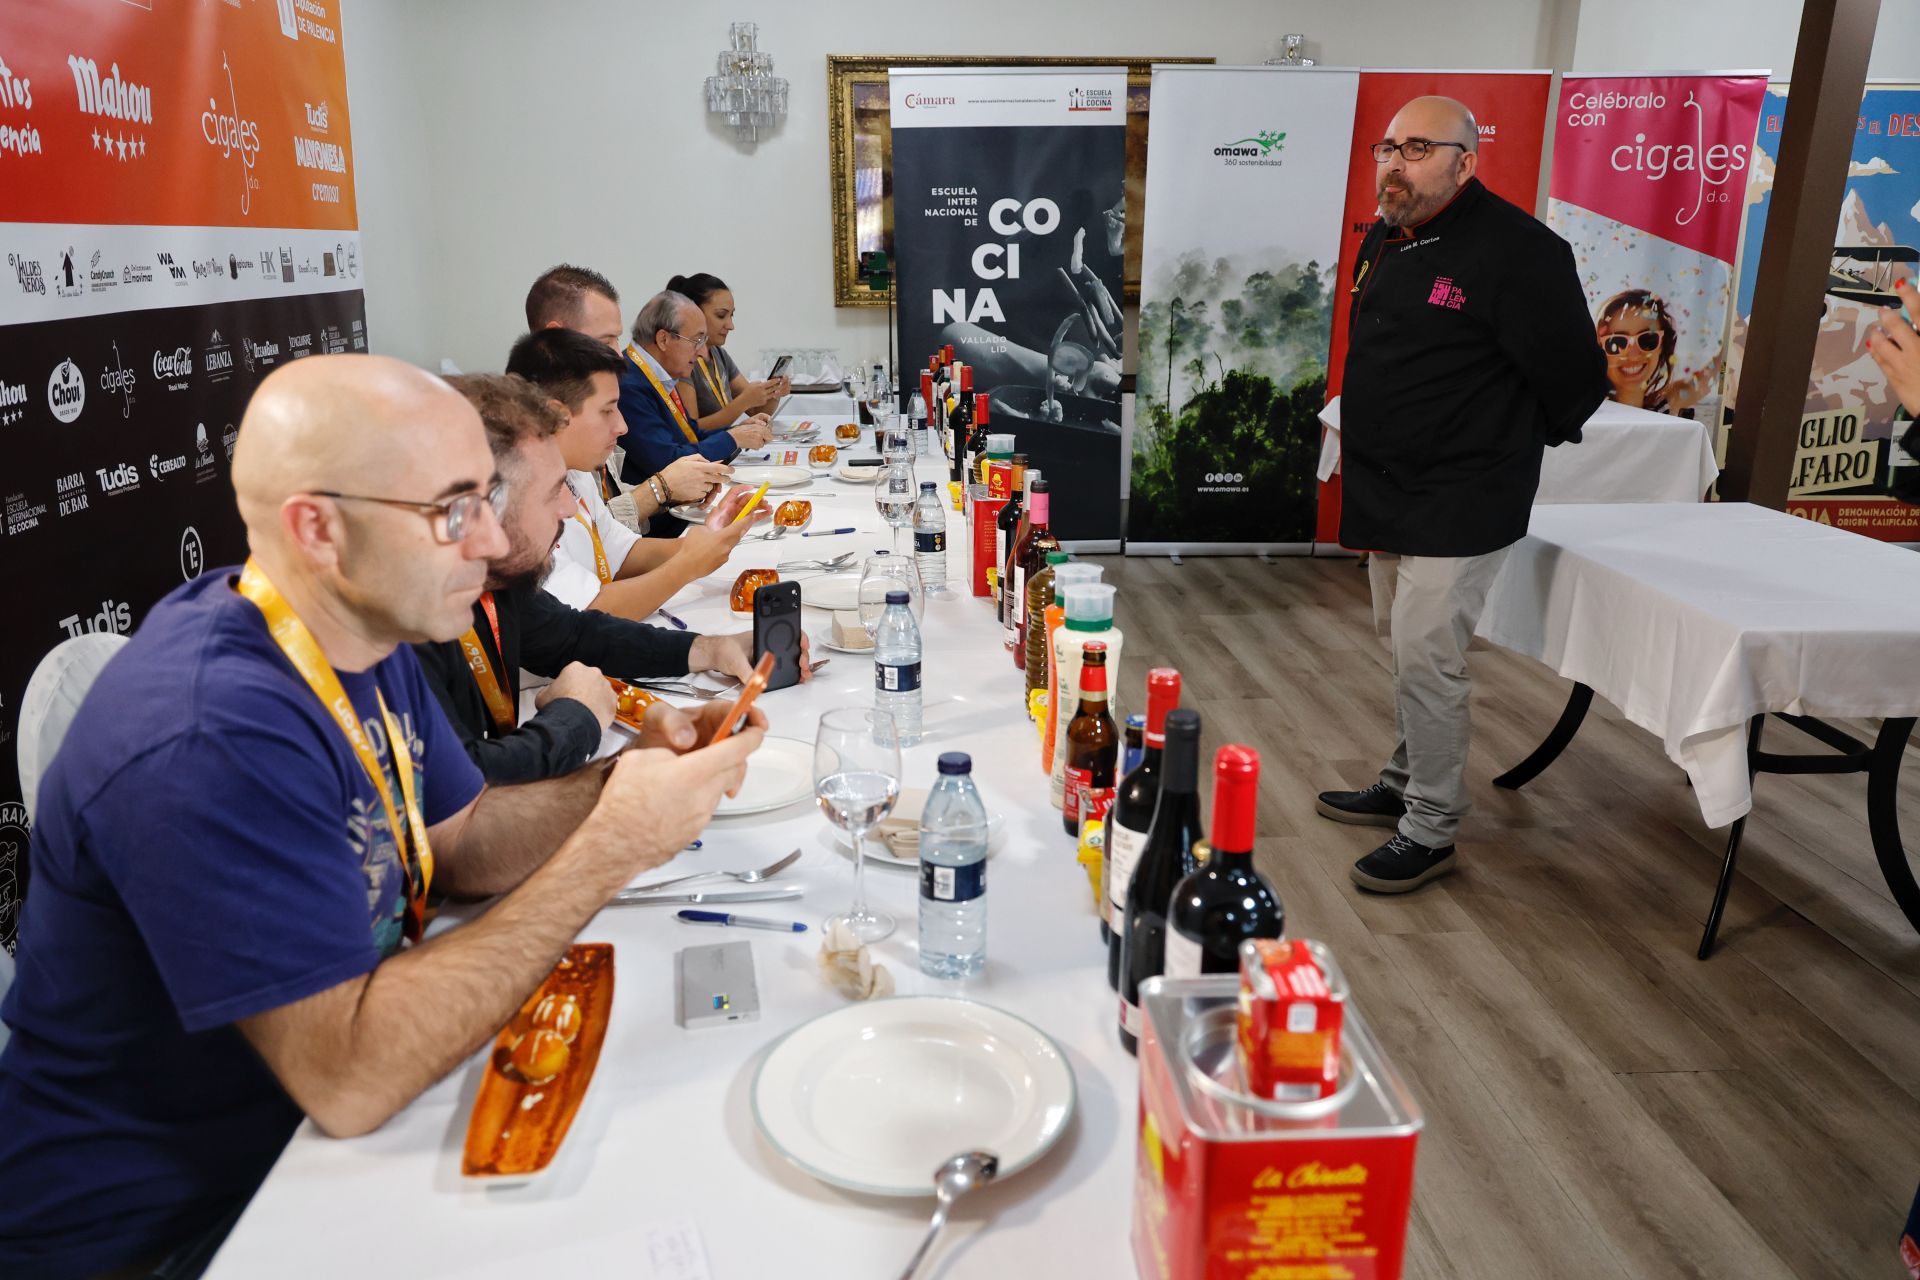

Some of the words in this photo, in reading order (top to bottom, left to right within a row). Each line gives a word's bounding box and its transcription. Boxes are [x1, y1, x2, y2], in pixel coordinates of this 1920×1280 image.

[298, 16, 307, 33] DE
[307, 19, 336, 44] PALENCIA
[67, 54, 152, 125] Mahou
[905, 93, 956, 109] Cámara
[1086, 99, 1112, 107] COCINA
[1569, 91, 1666, 111] Celébralo
[304, 101, 329, 129] Tudis
[1567, 112, 1606, 127] con
[1477, 125, 1496, 135] VAS
[1766, 115, 1783, 133] EL
[1868, 119, 1882, 135] EL
[1213, 147, 1258, 157] omawa
[1224, 158, 1238, 166] 360
[1238, 158, 1283, 167] sostenibilidad
[931, 187, 978, 196] ESCUELA
[1706, 190, 1731, 203] d.o.
[947, 198, 978, 206] INTER
[924, 208, 978, 217] NACIONAL
[988, 197, 1061, 236] CO
[964, 218, 978, 226] DE
[1400, 244, 1412, 252] Luis
[157, 253, 174, 266] WA
[260, 251, 276, 273] HK
[971, 242, 1020, 281] CI
[1449, 293, 1467, 304] LEN
[1451, 286, 1462, 296] PA
[932, 287, 1007, 324] NA
[1446, 301, 1461, 310] CIA
[960, 336, 1007, 345] VALLADO
[205, 351, 233, 372] LEBANZA
[159, 455, 187, 474] CEREALTO
[56, 472, 85, 493] BARRA
[96, 463, 140, 492] Tudis
[59, 488, 86, 500] CONSULTING
[7, 500, 28, 515] ESCUELA
[59, 500, 72, 517] DE
[71, 494, 89, 513] BAR
[1838, 504, 1906, 517] DENOMINACIÓN
[7, 504, 47, 525] INTERNACIONAL
[9, 524, 17, 536] DE
[17, 517, 39, 533] COCINA
[1837, 518, 1869, 527] ORIGEN
[1872, 518, 1918, 527] CALIFICADA
[59, 599, 131, 638] Tudis
